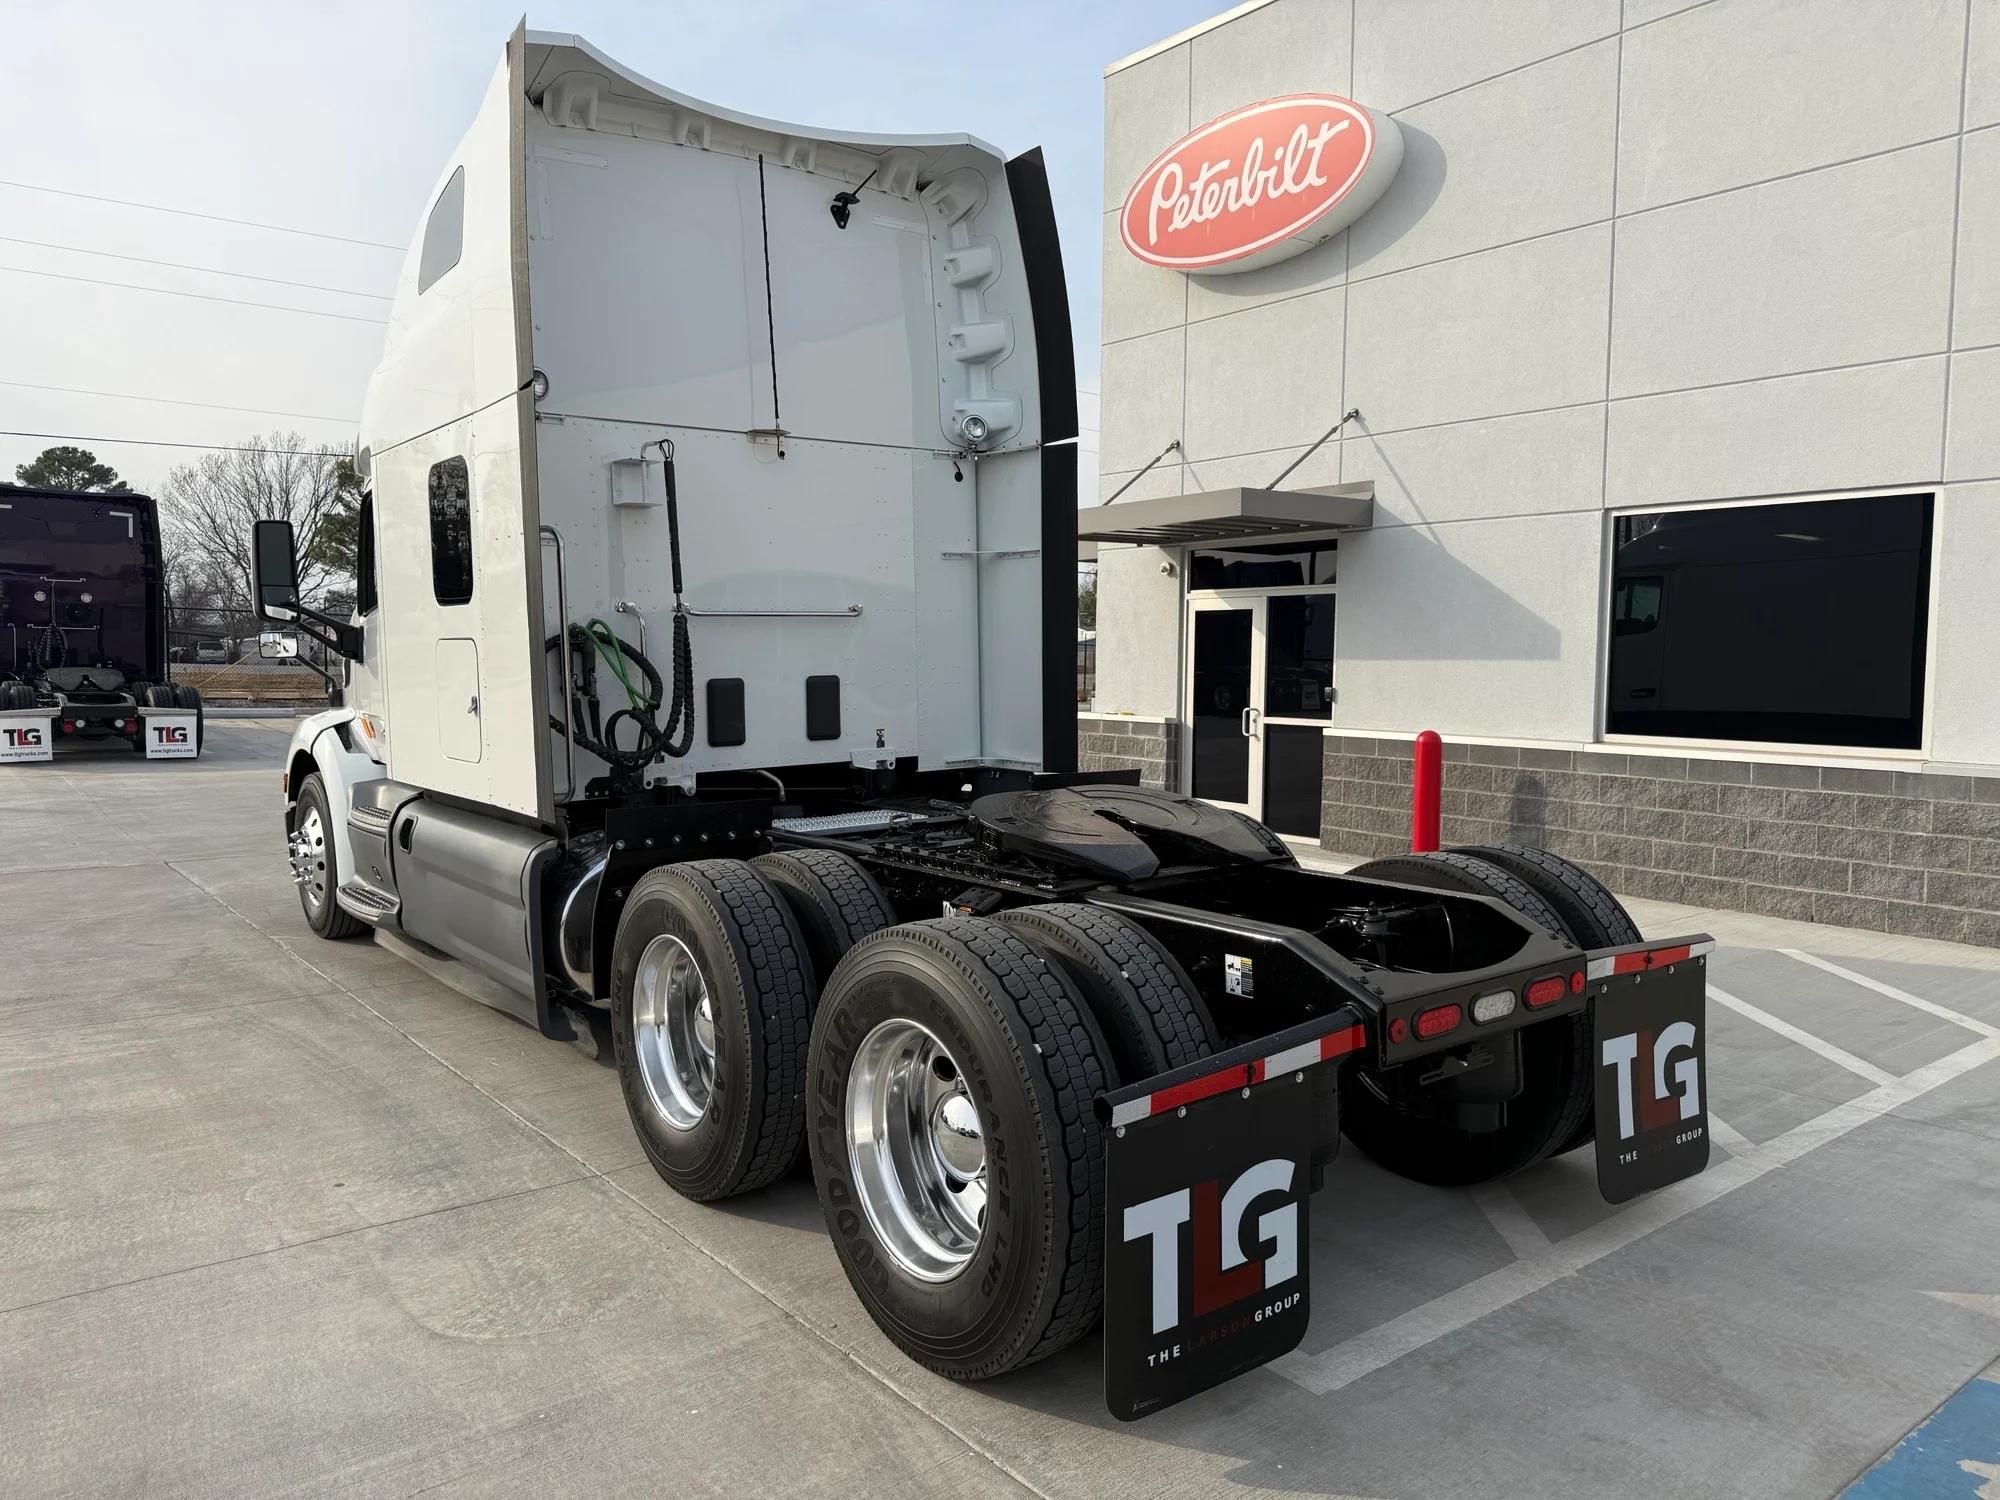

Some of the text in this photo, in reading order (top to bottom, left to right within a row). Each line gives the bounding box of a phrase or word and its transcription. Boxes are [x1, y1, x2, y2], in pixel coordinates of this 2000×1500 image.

[1149, 119, 1350, 246] Peterbilt
[3, 728, 42, 746] TLG
[153, 726, 188, 743] TLG
[1603, 1021, 1700, 1140] TLG
[1619, 1127, 1703, 1165] THE GROUP
[1124, 1158, 1298, 1335] TLG
[1147, 1344, 1182, 1368] THE
[1254, 1292, 1301, 1323] GROUP
